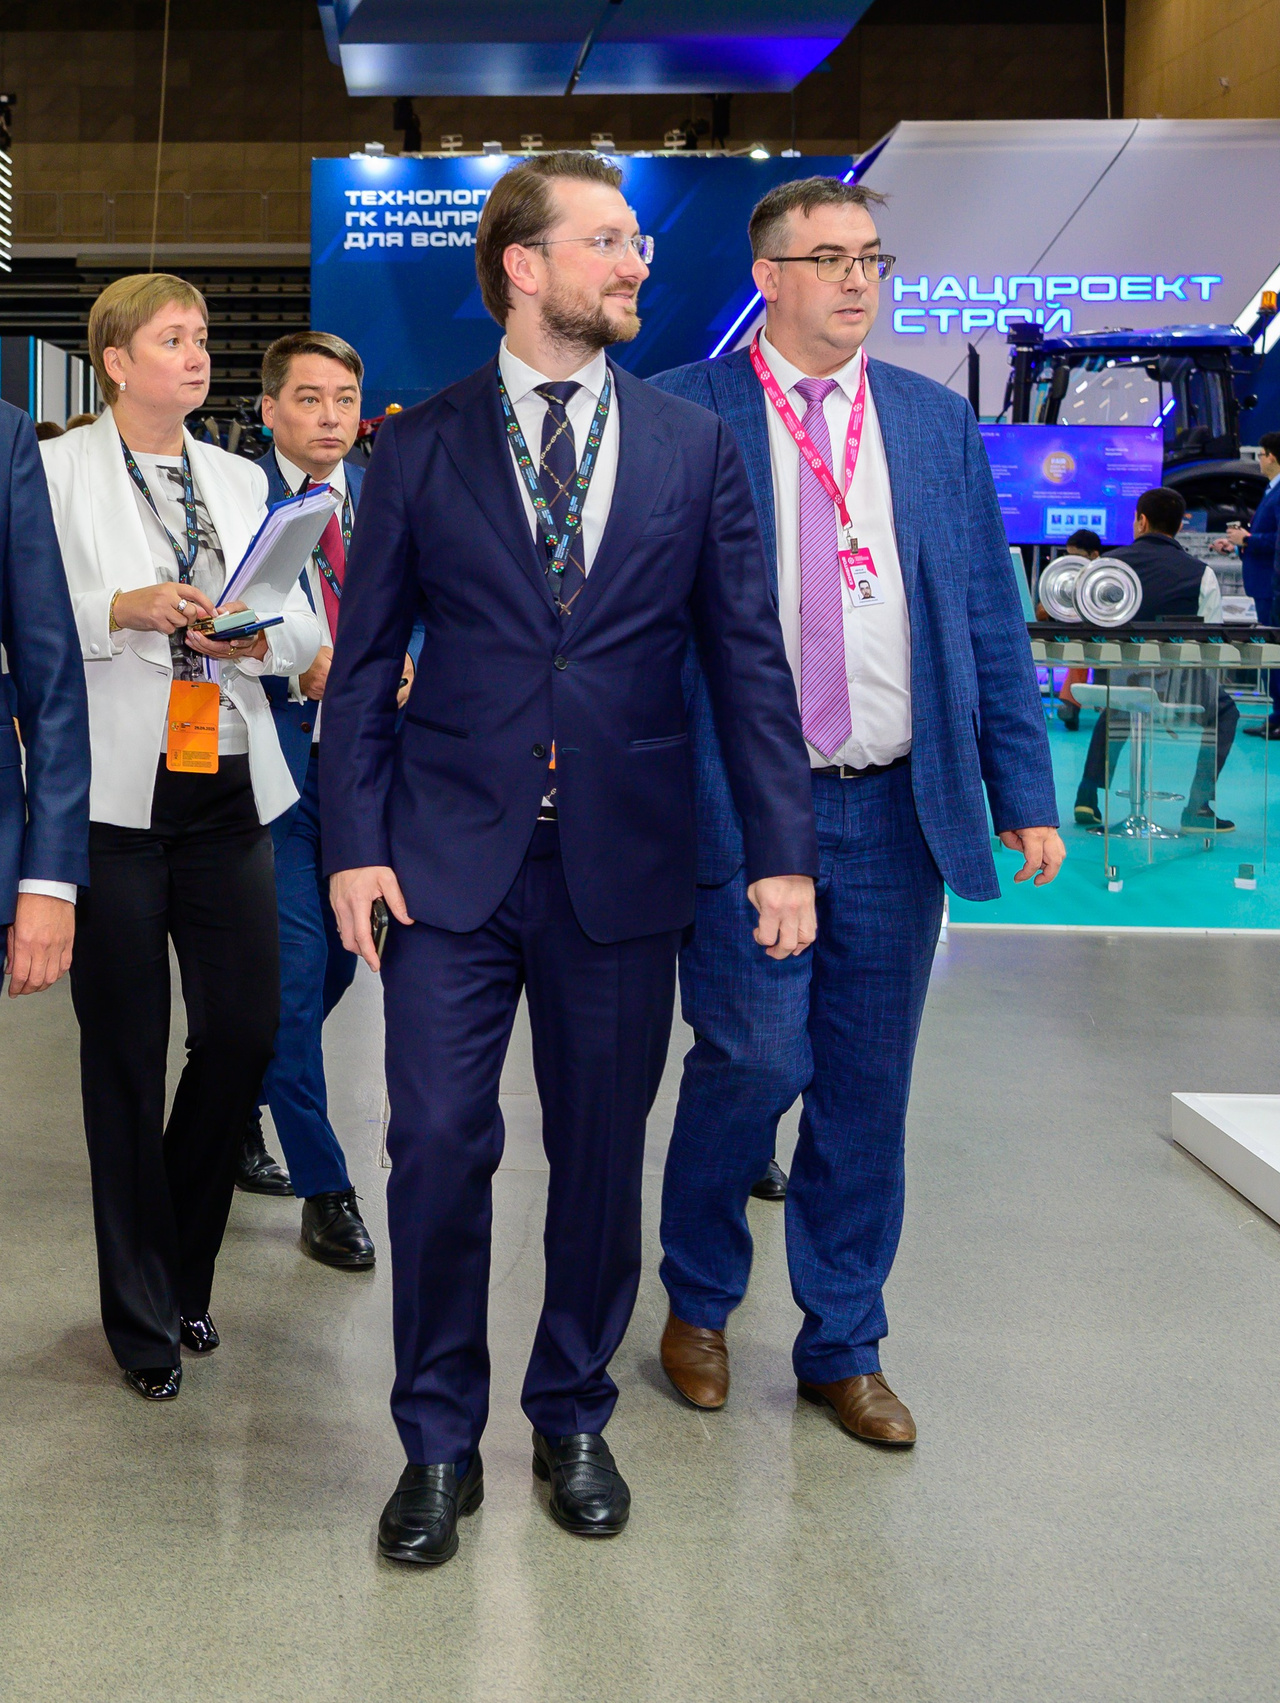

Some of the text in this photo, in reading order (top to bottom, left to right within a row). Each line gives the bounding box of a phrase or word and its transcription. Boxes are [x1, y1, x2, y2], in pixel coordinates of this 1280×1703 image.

[344, 189, 490, 206] ТЕХНОЛОГ
[344, 210, 378, 227] ГК
[343, 232, 404, 250] ДЛЯ
[893, 276, 1221, 305] НАЦПРОЕКТ
[893, 302, 1072, 333] СТРОЙ
